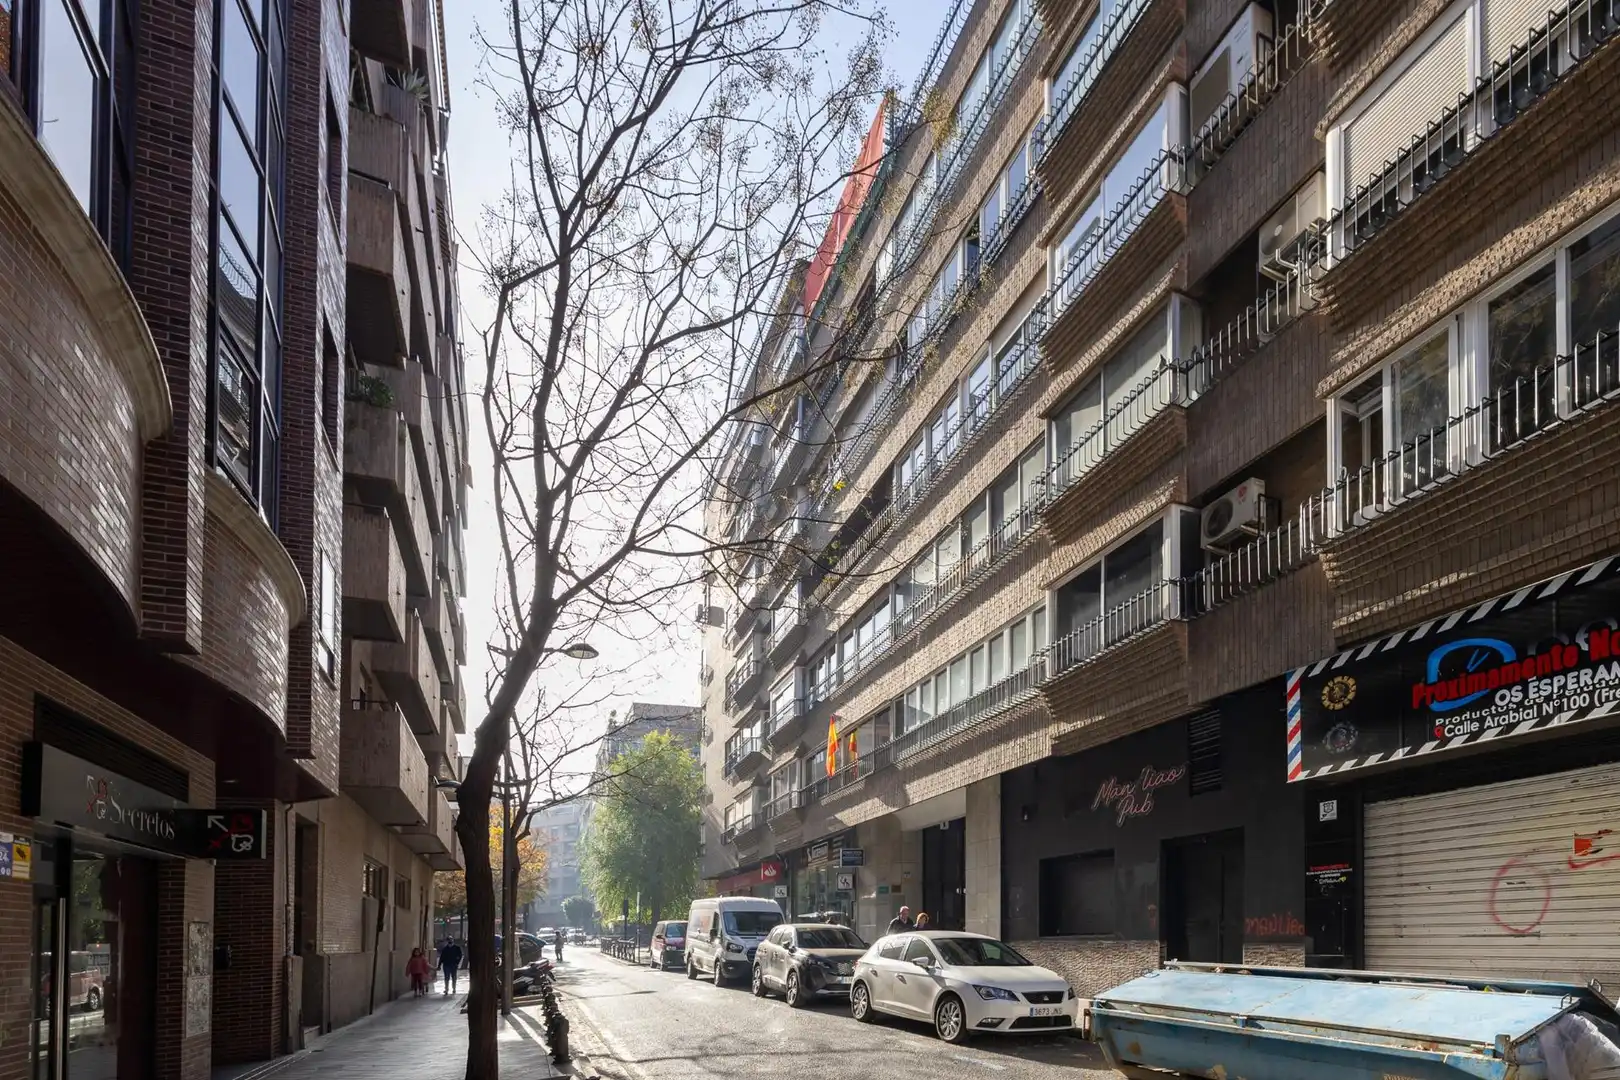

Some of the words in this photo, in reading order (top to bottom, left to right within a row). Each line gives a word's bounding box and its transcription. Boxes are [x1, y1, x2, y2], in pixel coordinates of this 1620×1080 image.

[1412, 643, 1579, 709] Proximamente
[1494, 684, 1524, 707] OS
[1444, 721, 1480, 737] Calle
[1484, 705, 1538, 729] Arabial
[1091, 777, 1136, 811] Man
[1117, 792, 1155, 827] Pub
[110, 795, 175, 840] Secretos
